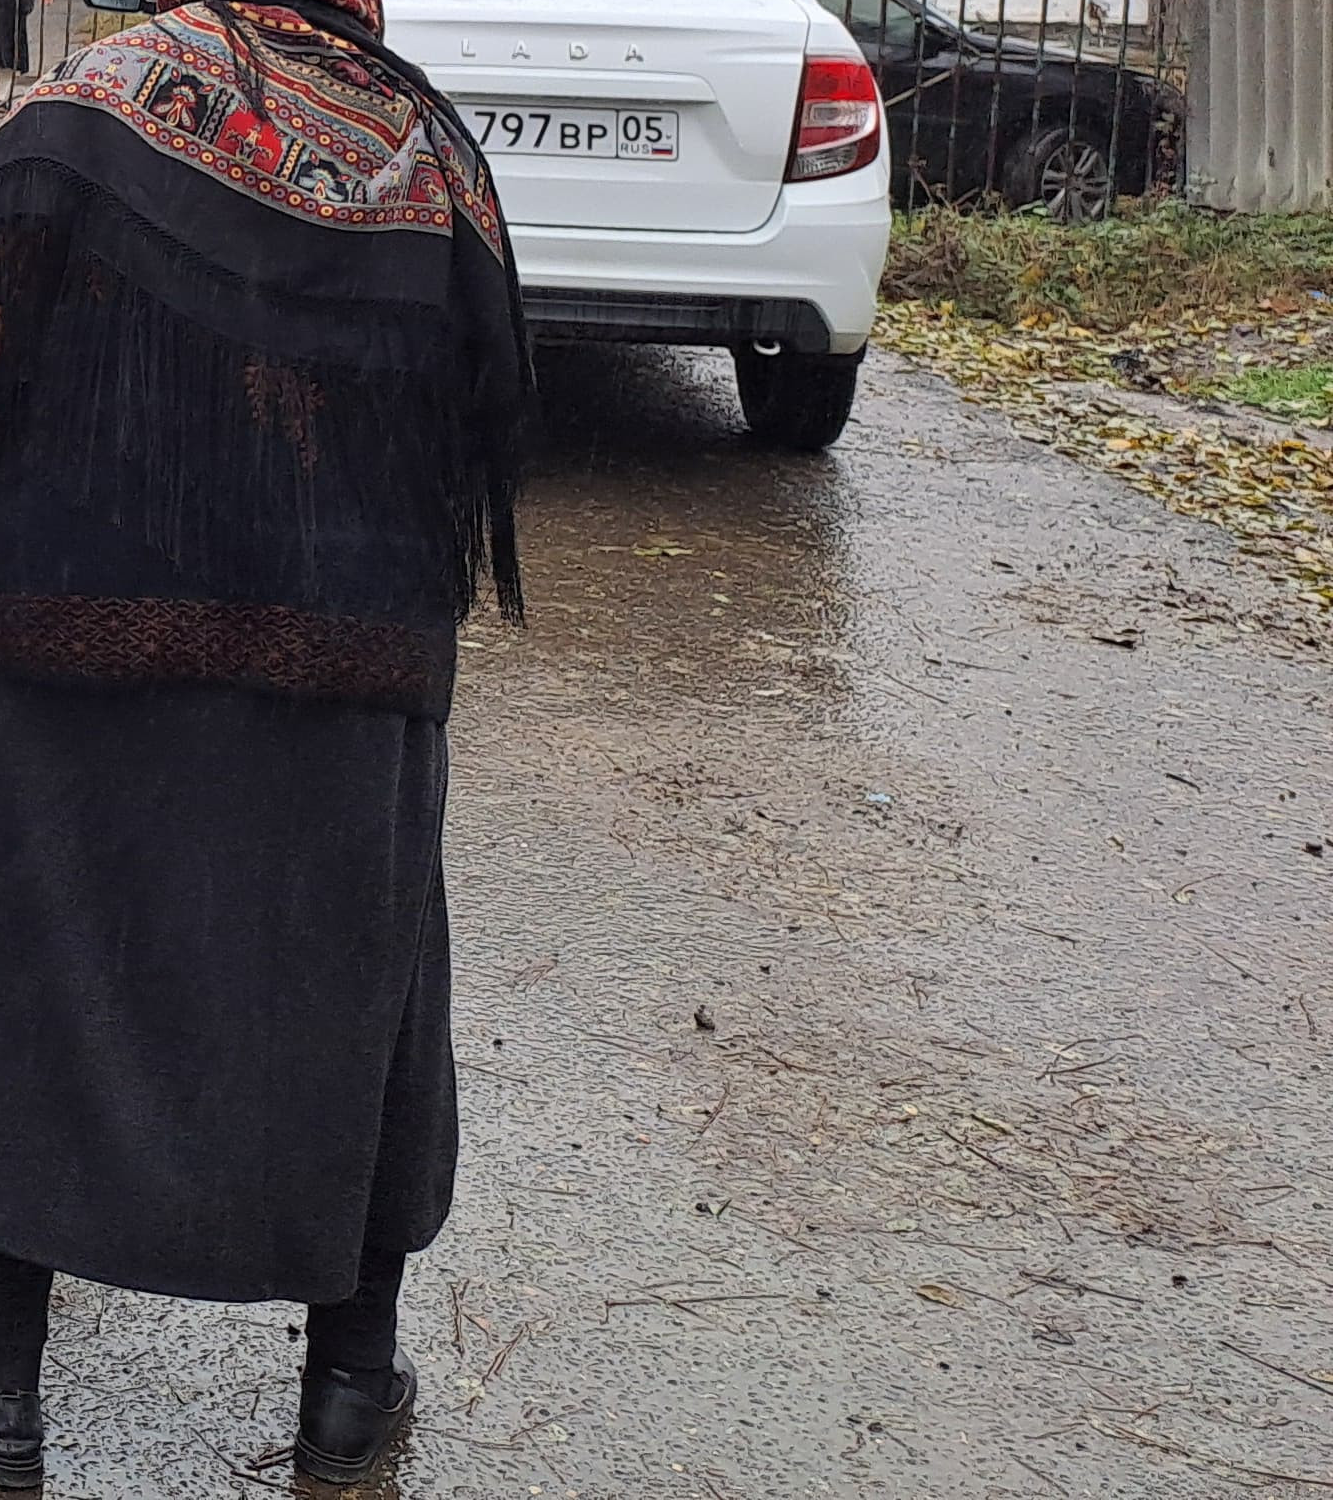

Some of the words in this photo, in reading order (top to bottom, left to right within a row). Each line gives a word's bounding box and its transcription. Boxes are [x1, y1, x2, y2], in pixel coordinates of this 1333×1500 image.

[461, 37, 644, 62] LADA
[474, 110, 609, 150] 797ВР
[622, 114, 663, 143] 05
[620, 143, 650, 155] RUS
